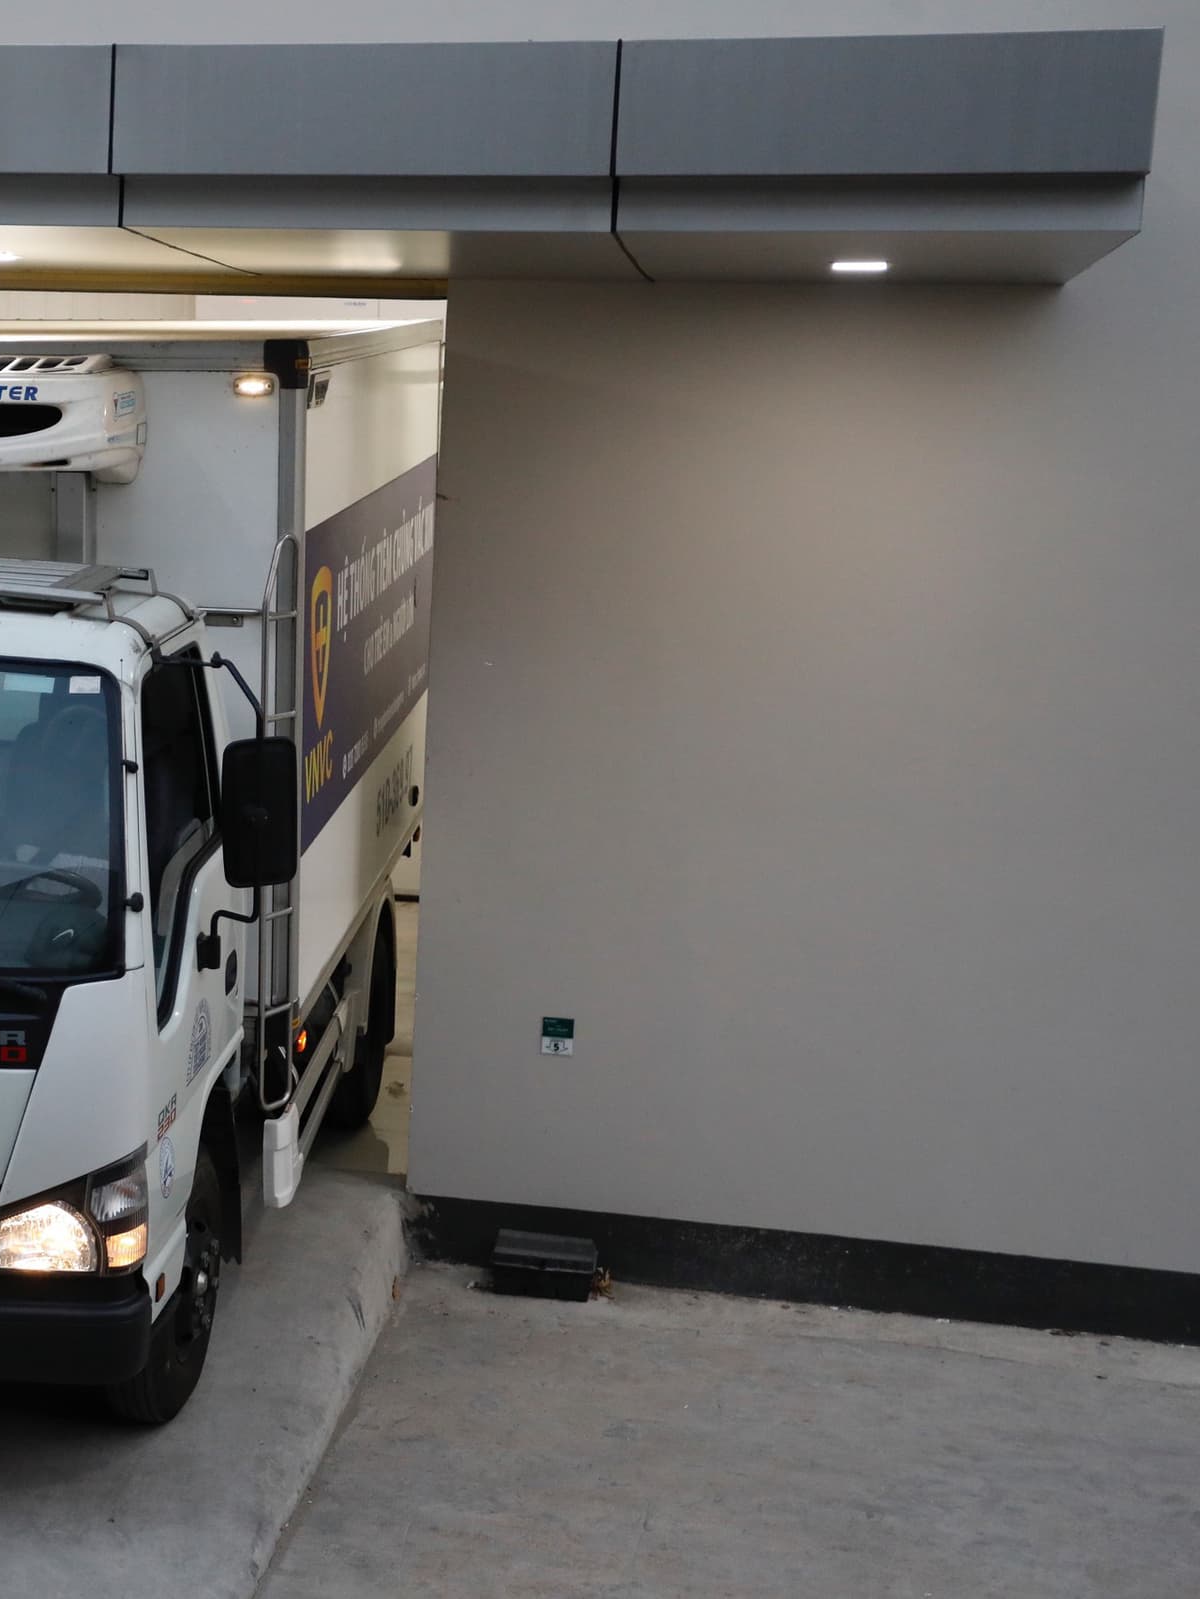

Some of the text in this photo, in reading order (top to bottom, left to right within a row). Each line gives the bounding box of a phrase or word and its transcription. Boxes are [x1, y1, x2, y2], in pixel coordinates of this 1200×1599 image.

[349, 536, 376, 620] THỐNG
[376, 528, 393, 597] TIÊM
[305, 729, 333, 804] VNVC
